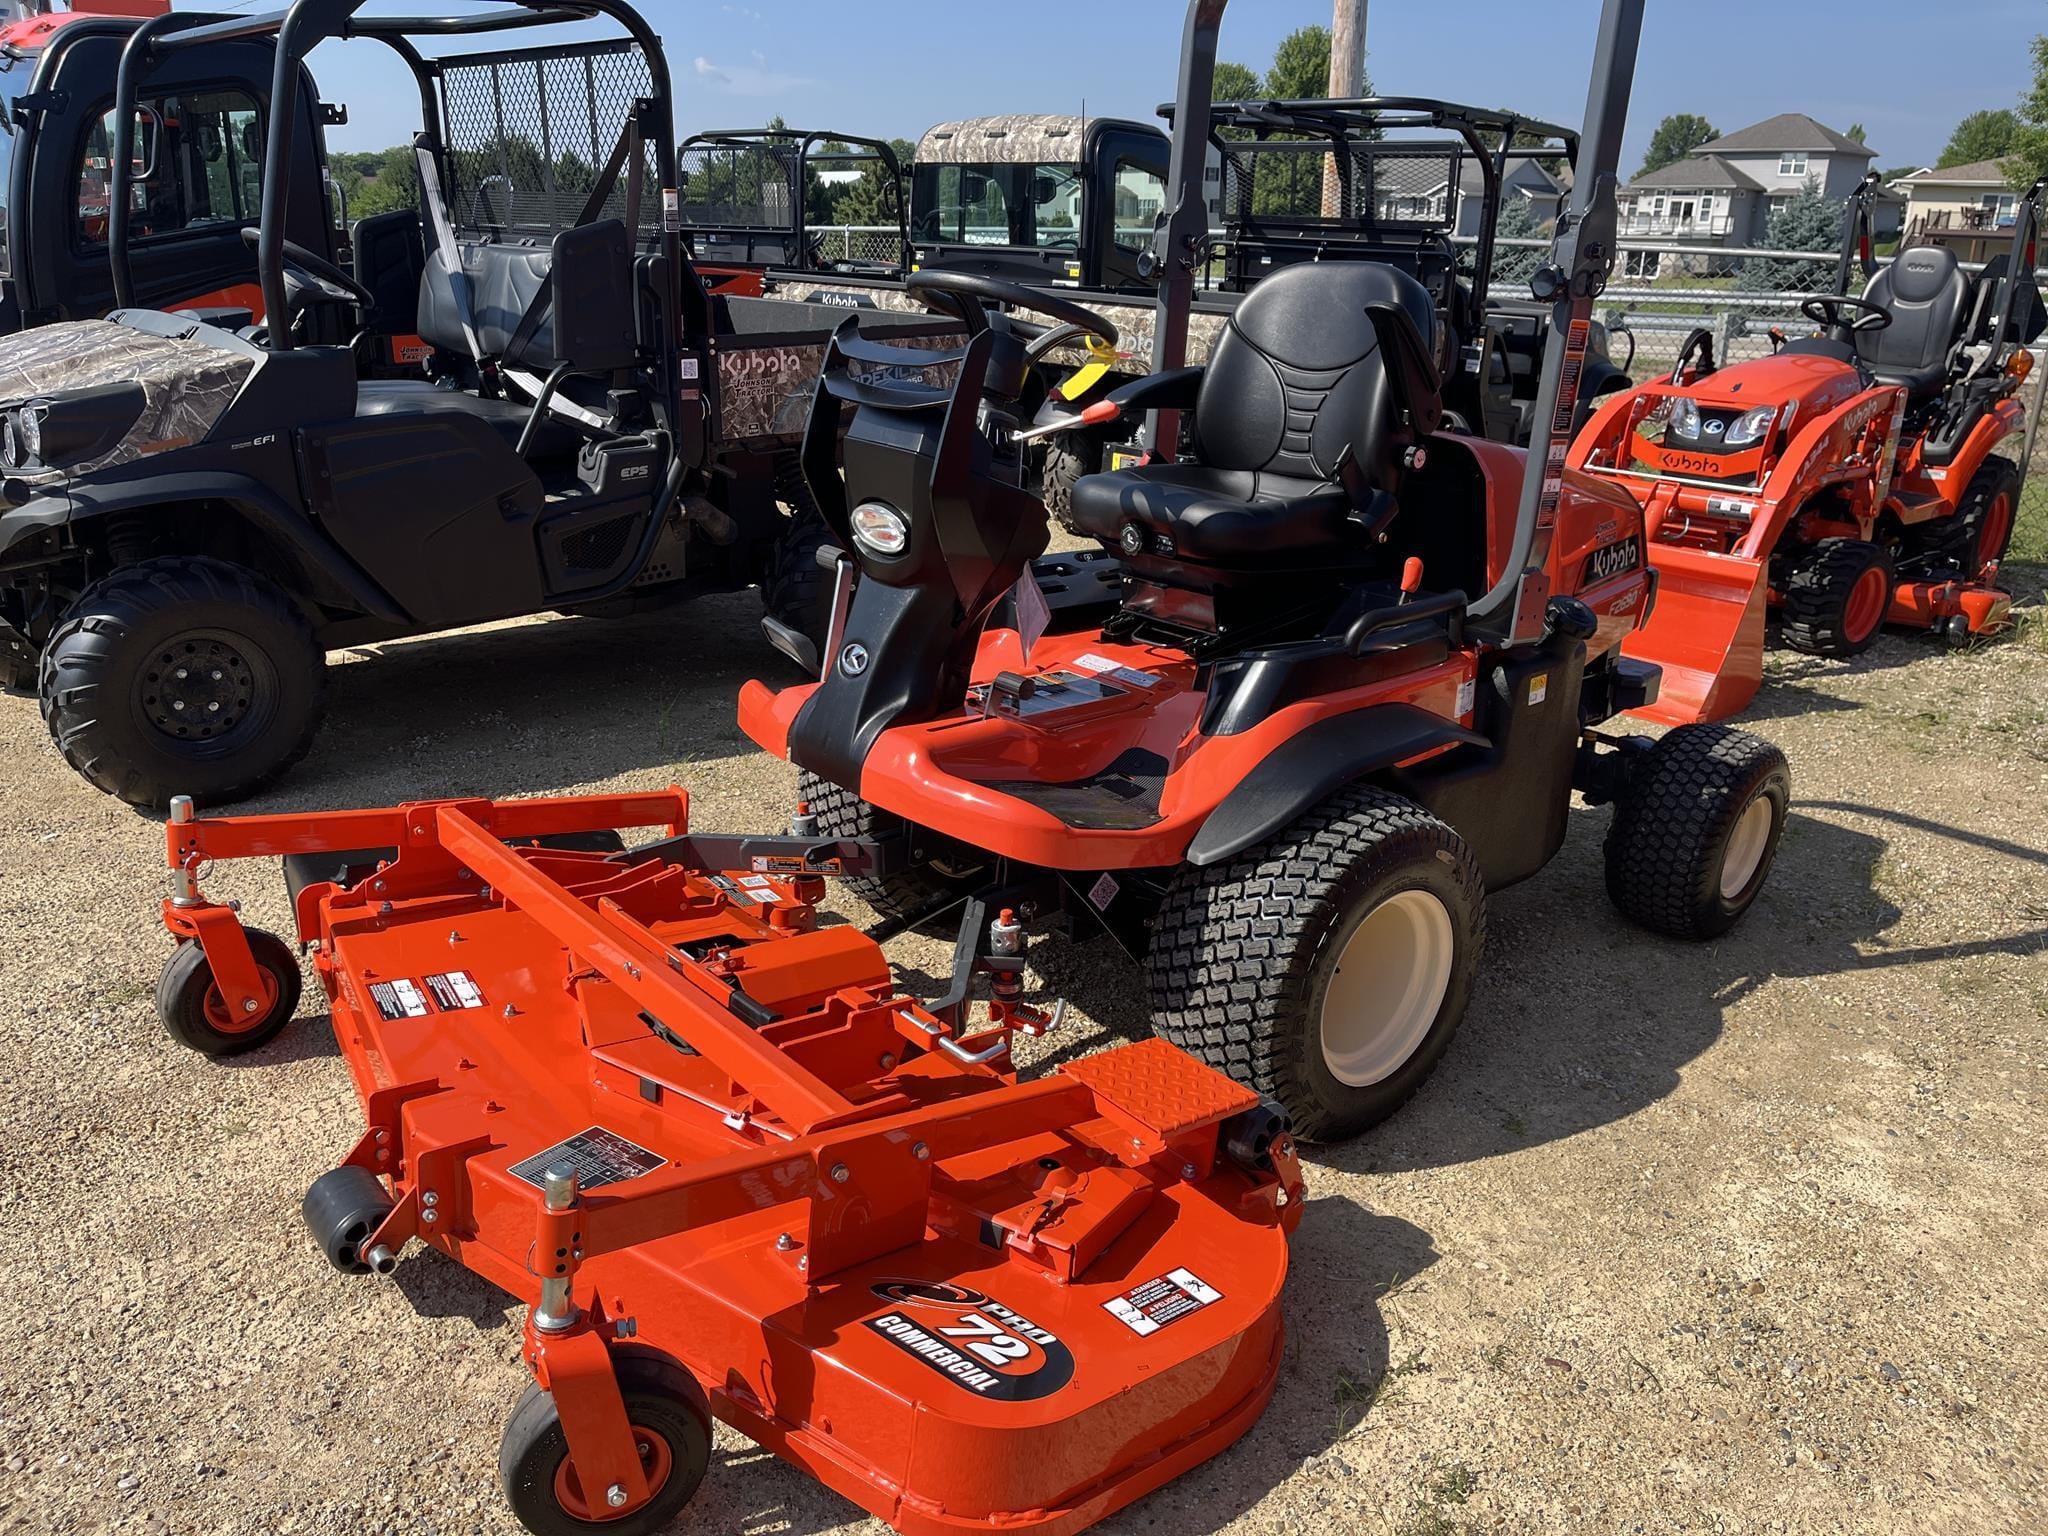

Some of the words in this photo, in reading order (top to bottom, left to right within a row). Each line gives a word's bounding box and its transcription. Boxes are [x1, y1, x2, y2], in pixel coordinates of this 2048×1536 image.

[822, 293, 858, 308] Kubota
[720, 349, 800, 376] Kubota
[734, 378, 771, 389] JOHNSON
[735, 388, 771, 398] TRACTOR
[253, 434, 275, 446] EFI
[620, 464, 649, 477] EPS
[1660, 452, 1719, 473] Kubota
[1593, 539, 1636, 577] Kubota
[1153, 1294, 1182, 1308] PELIGRO
[979, 1302, 1057, 1345] PRO
[938, 1313, 1030, 1366] 72
[873, 1314, 1000, 1392] COMMERCIAL
